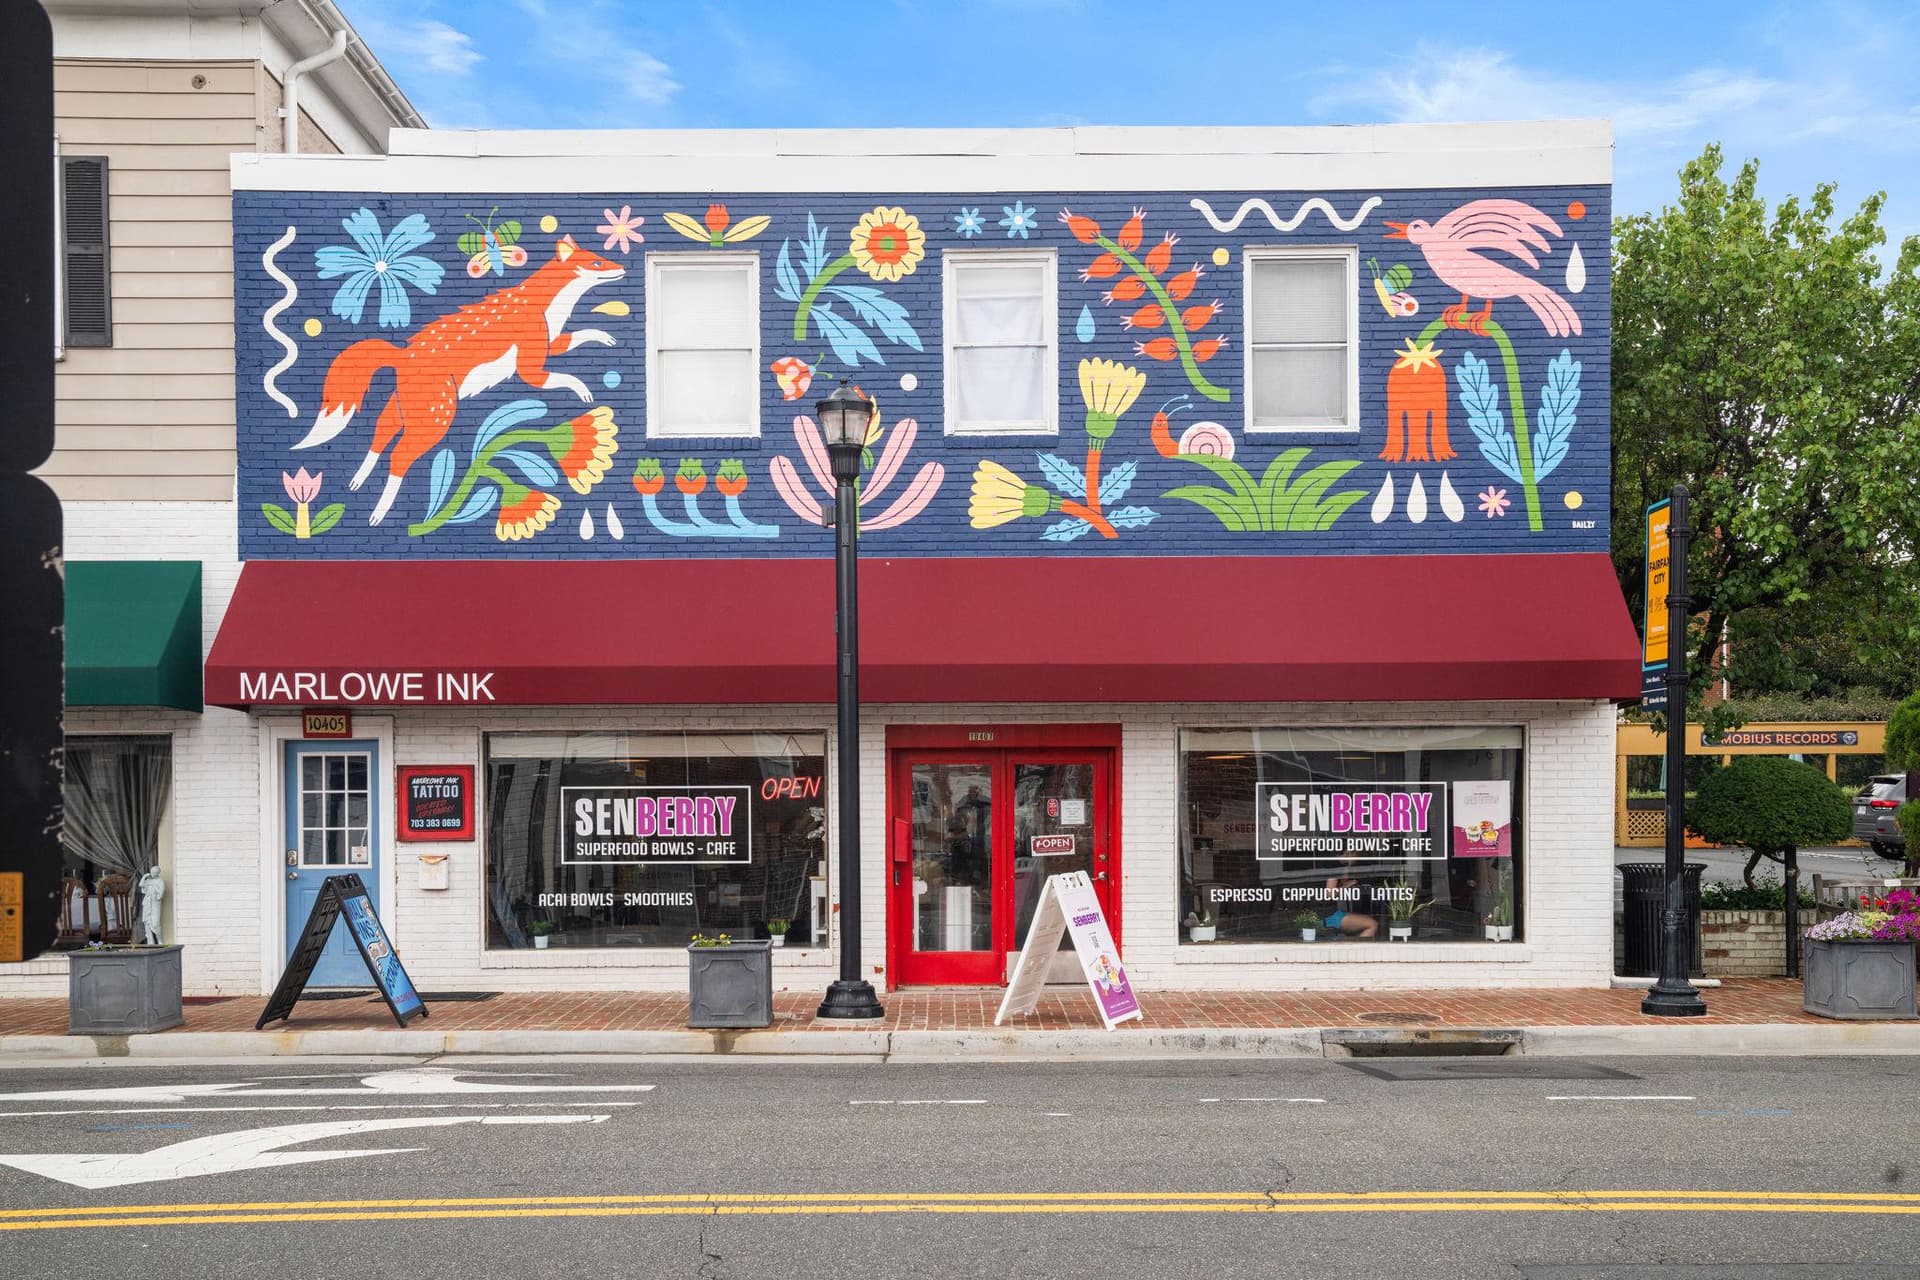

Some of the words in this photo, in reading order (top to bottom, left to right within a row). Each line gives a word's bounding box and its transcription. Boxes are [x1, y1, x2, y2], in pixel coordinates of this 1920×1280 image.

[240, 672, 424, 701] MARLOWE
[437, 672, 495, 701] INK
[308, 717, 344, 731] 10405
[1775, 733, 1838, 744] RECORDS
[412, 785, 459, 798] TATTOO
[761, 776, 821, 801] OPEN
[575, 796, 736, 837] SENBERRY
[1270, 793, 1432, 832] SENBERRY
[411, 819, 424, 828] 703
[426, 819, 440, 828] 383
[441, 818, 461, 828] 0699
[576, 842, 648, 856] SUPERFOOD
[652, 842, 694, 856] BOWLS
[706, 841, 736, 855] CAFE
[1042, 839, 1070, 848] OPEN
[1271, 838, 1343, 852] SUPERFOOD
[1347, 838, 1389, 852] BOWLS
[1402, 838, 1432, 852] CAFE
[538, 893, 567, 907] ACAI
[571, 893, 614, 906] BOWLS
[624, 892, 693, 906] SMOOTHIES
[1210, 889, 1272, 902] ESPRESSO
[1282, 888, 1361, 901] CAPPUCCINO
[1371, 888, 1413, 901] LATTES
